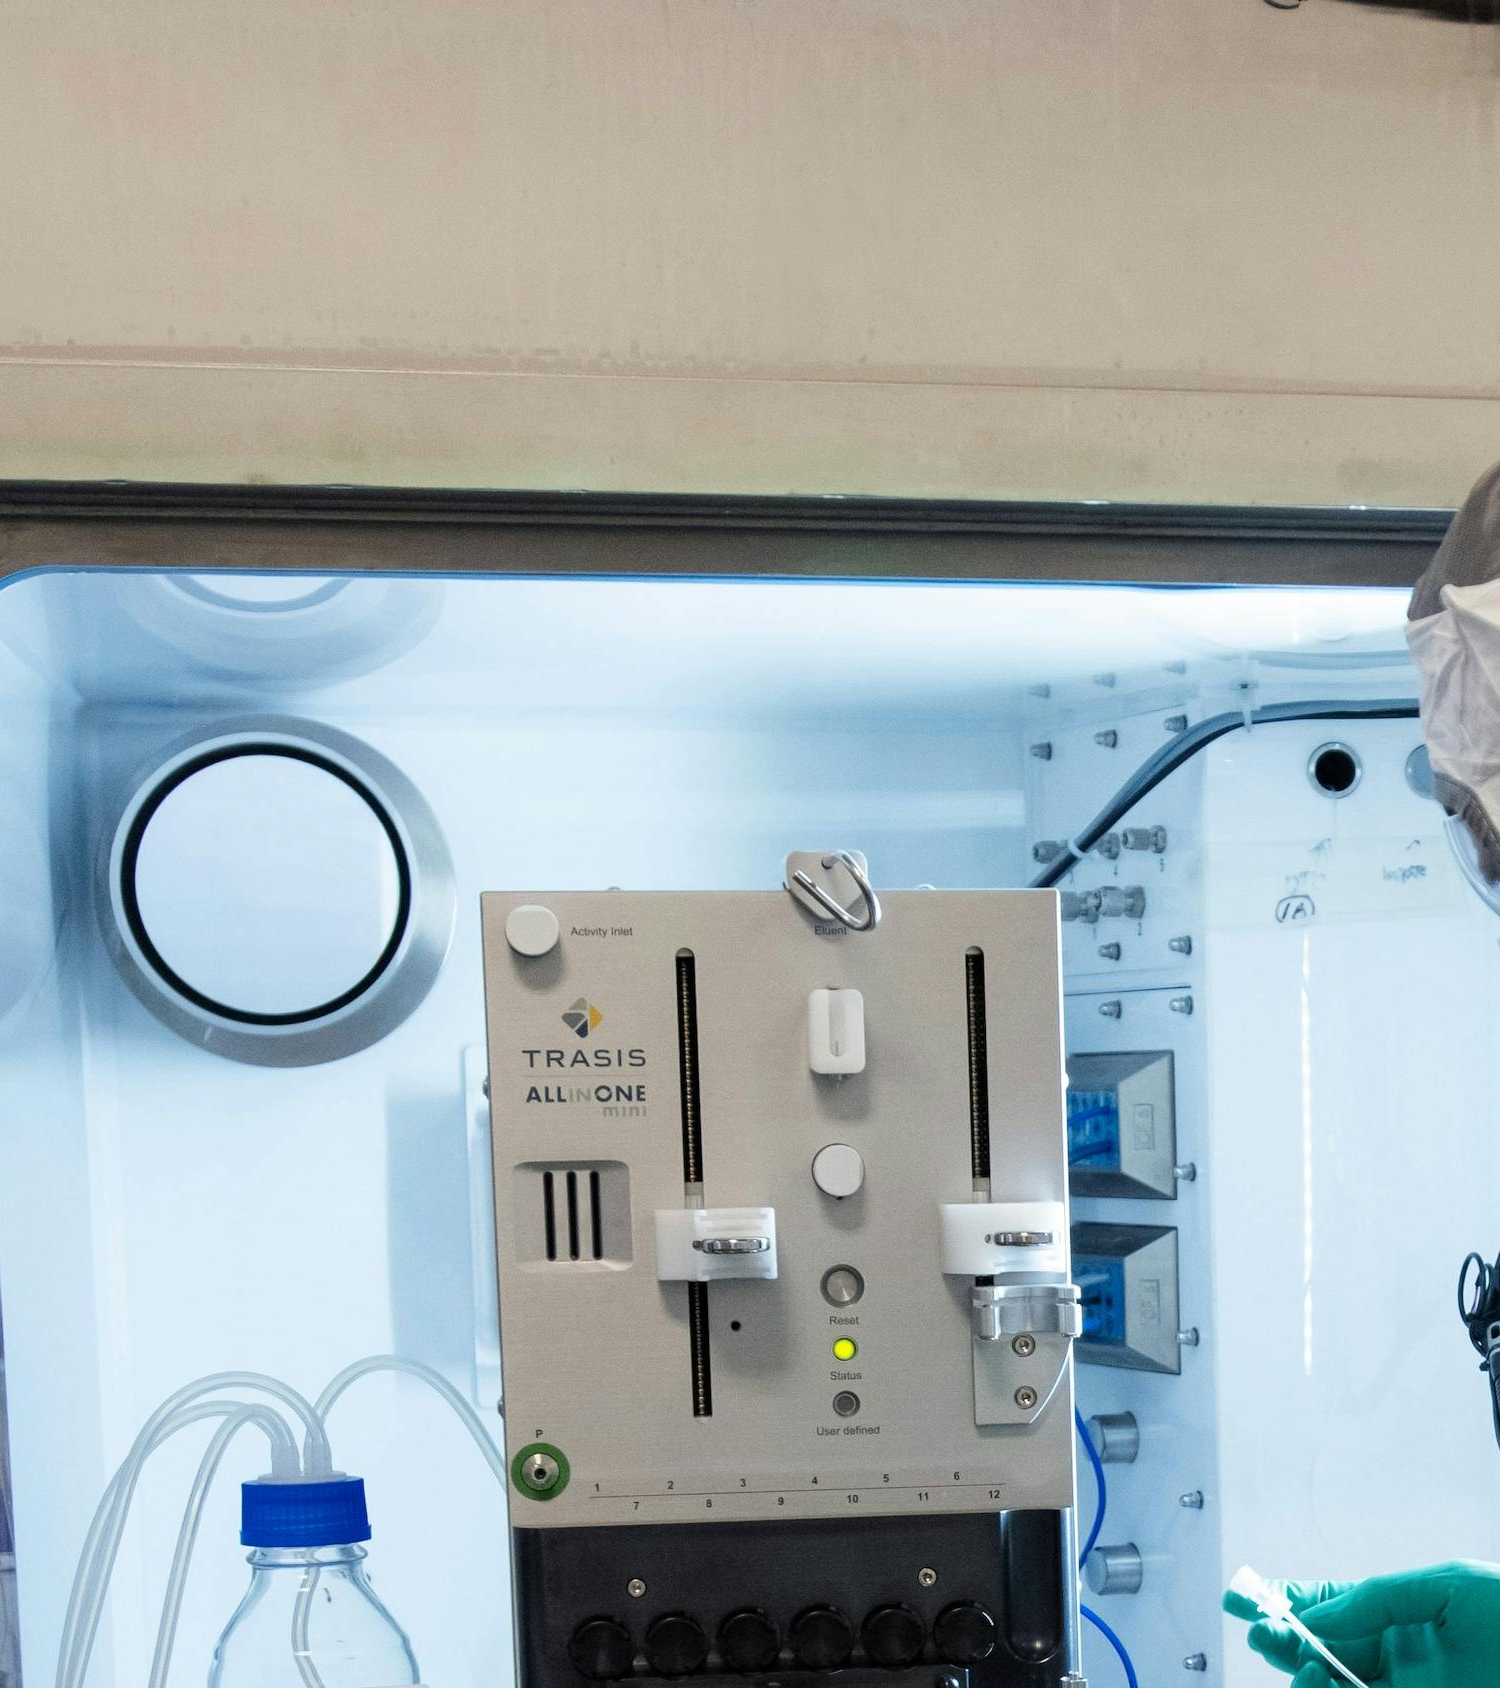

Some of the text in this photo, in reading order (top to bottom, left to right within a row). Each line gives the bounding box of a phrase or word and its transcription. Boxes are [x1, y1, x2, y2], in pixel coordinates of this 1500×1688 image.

[570, 926, 633, 939] Activity Inlet
[814, 924, 848, 936] Eluent
[521, 1048, 647, 1069] TRASIS
[525, 1084, 647, 1103] ALLINONE
[602, 1105, 648, 1118] mini
[828, 1315, 860, 1326] Reset
[829, 1370, 863, 1381] Status
[535, 1429, 544, 1439] P
[816, 1425, 881, 1437] User defined
[594, 1472, 961, 1492] 1 2 3 4 5 6
[632, 1489, 1001, 1511] 7 8 9 10 11 12
